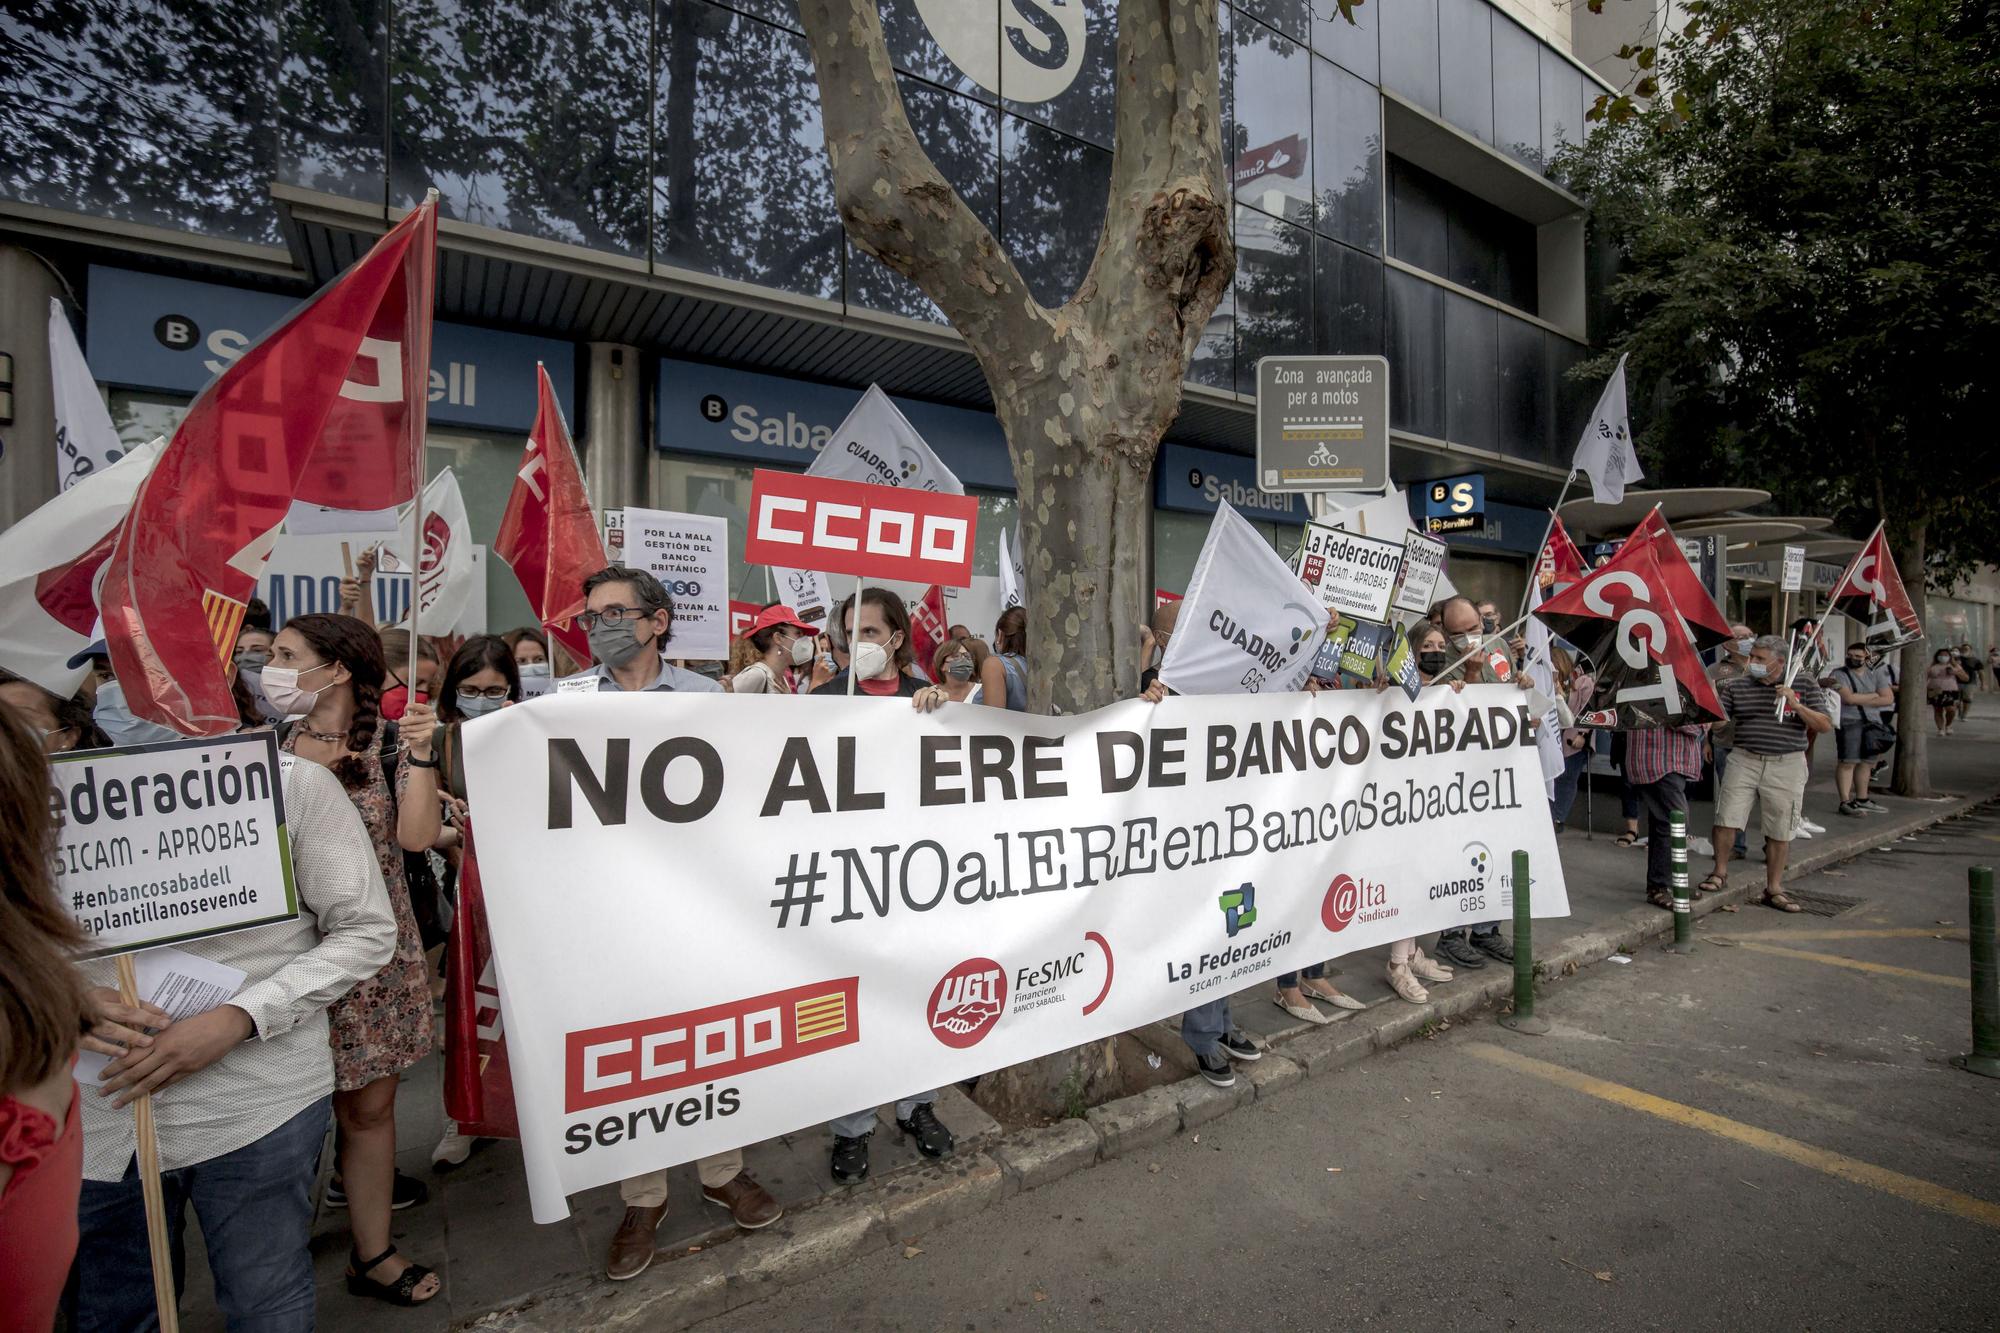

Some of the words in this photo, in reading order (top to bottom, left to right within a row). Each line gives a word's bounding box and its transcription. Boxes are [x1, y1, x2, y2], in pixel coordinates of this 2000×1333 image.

[1275, 367, 1304, 384] Zona
[1317, 366, 1372, 388] avançada
[1288, 390, 1307, 409] per
[1311, 393, 1318, 405] a
[1322, 389, 1359, 405] motos
[846, 441, 901, 488] CUADROS
[1451, 483, 1474, 513] S
[604, 513, 616, 528] La
[757, 494, 968, 563] CCOO
[1443, 517, 1474, 530] ServiRed
[644, 529, 665, 538] POR
[669, 531, 681, 539] LA
[685, 533, 713, 542] MALA
[645, 539, 690, 551] GESTIÓN
[693, 544, 712, 553] DEL
[661, 552, 697, 562] BANCO
[1305, 529, 1320, 553] La
[1322, 534, 1398, 572] Federación
[1308, 555, 1323, 567] ERE
[651, 562, 707, 574] BRITÁNICO
[1307, 566, 1319, 577] NO
[1325, 563, 1349, 580] SICAM
[1353, 572, 1388, 590] APROBAS
[707, 603, 720, 612] AL
[1209, 609, 1287, 674] CUADROS
[1583, 571, 1682, 715] CGT
[547, 735, 724, 830] NO
[759, 736, 886, 818] AL
[920, 735, 1068, 807] ERE
[1096, 728, 1187, 794] DE
[1207, 716, 1370, 782] BANCO
[158, 818, 260, 861] APROBAS
[770, 767, 1522, 929] #NOalEREenBancoSabadell
[72, 865, 232, 911] #enbancosabadell
[1429, 877, 1485, 900] CUADROS
[1358, 908, 1399, 925] Sindicato
[1460, 895, 1486, 912] GBS
[1167, 962, 1192, 983] La
[1199, 930, 1292, 975] Federación
[1016, 952, 1085, 991] FeSMC
[1189, 976, 1221, 995] SICAM
[1231, 957, 1272, 980] APROBAS
[942, 969, 999, 1004] UGT
[1014, 985, 1057, 1003] Financiero
[1013, 1001, 1035, 1014] BANCO
[1036, 993, 1066, 1008] SABADELL
[583, 1006, 783, 1093] CCOO
[564, 1084, 741, 1156] serveis
